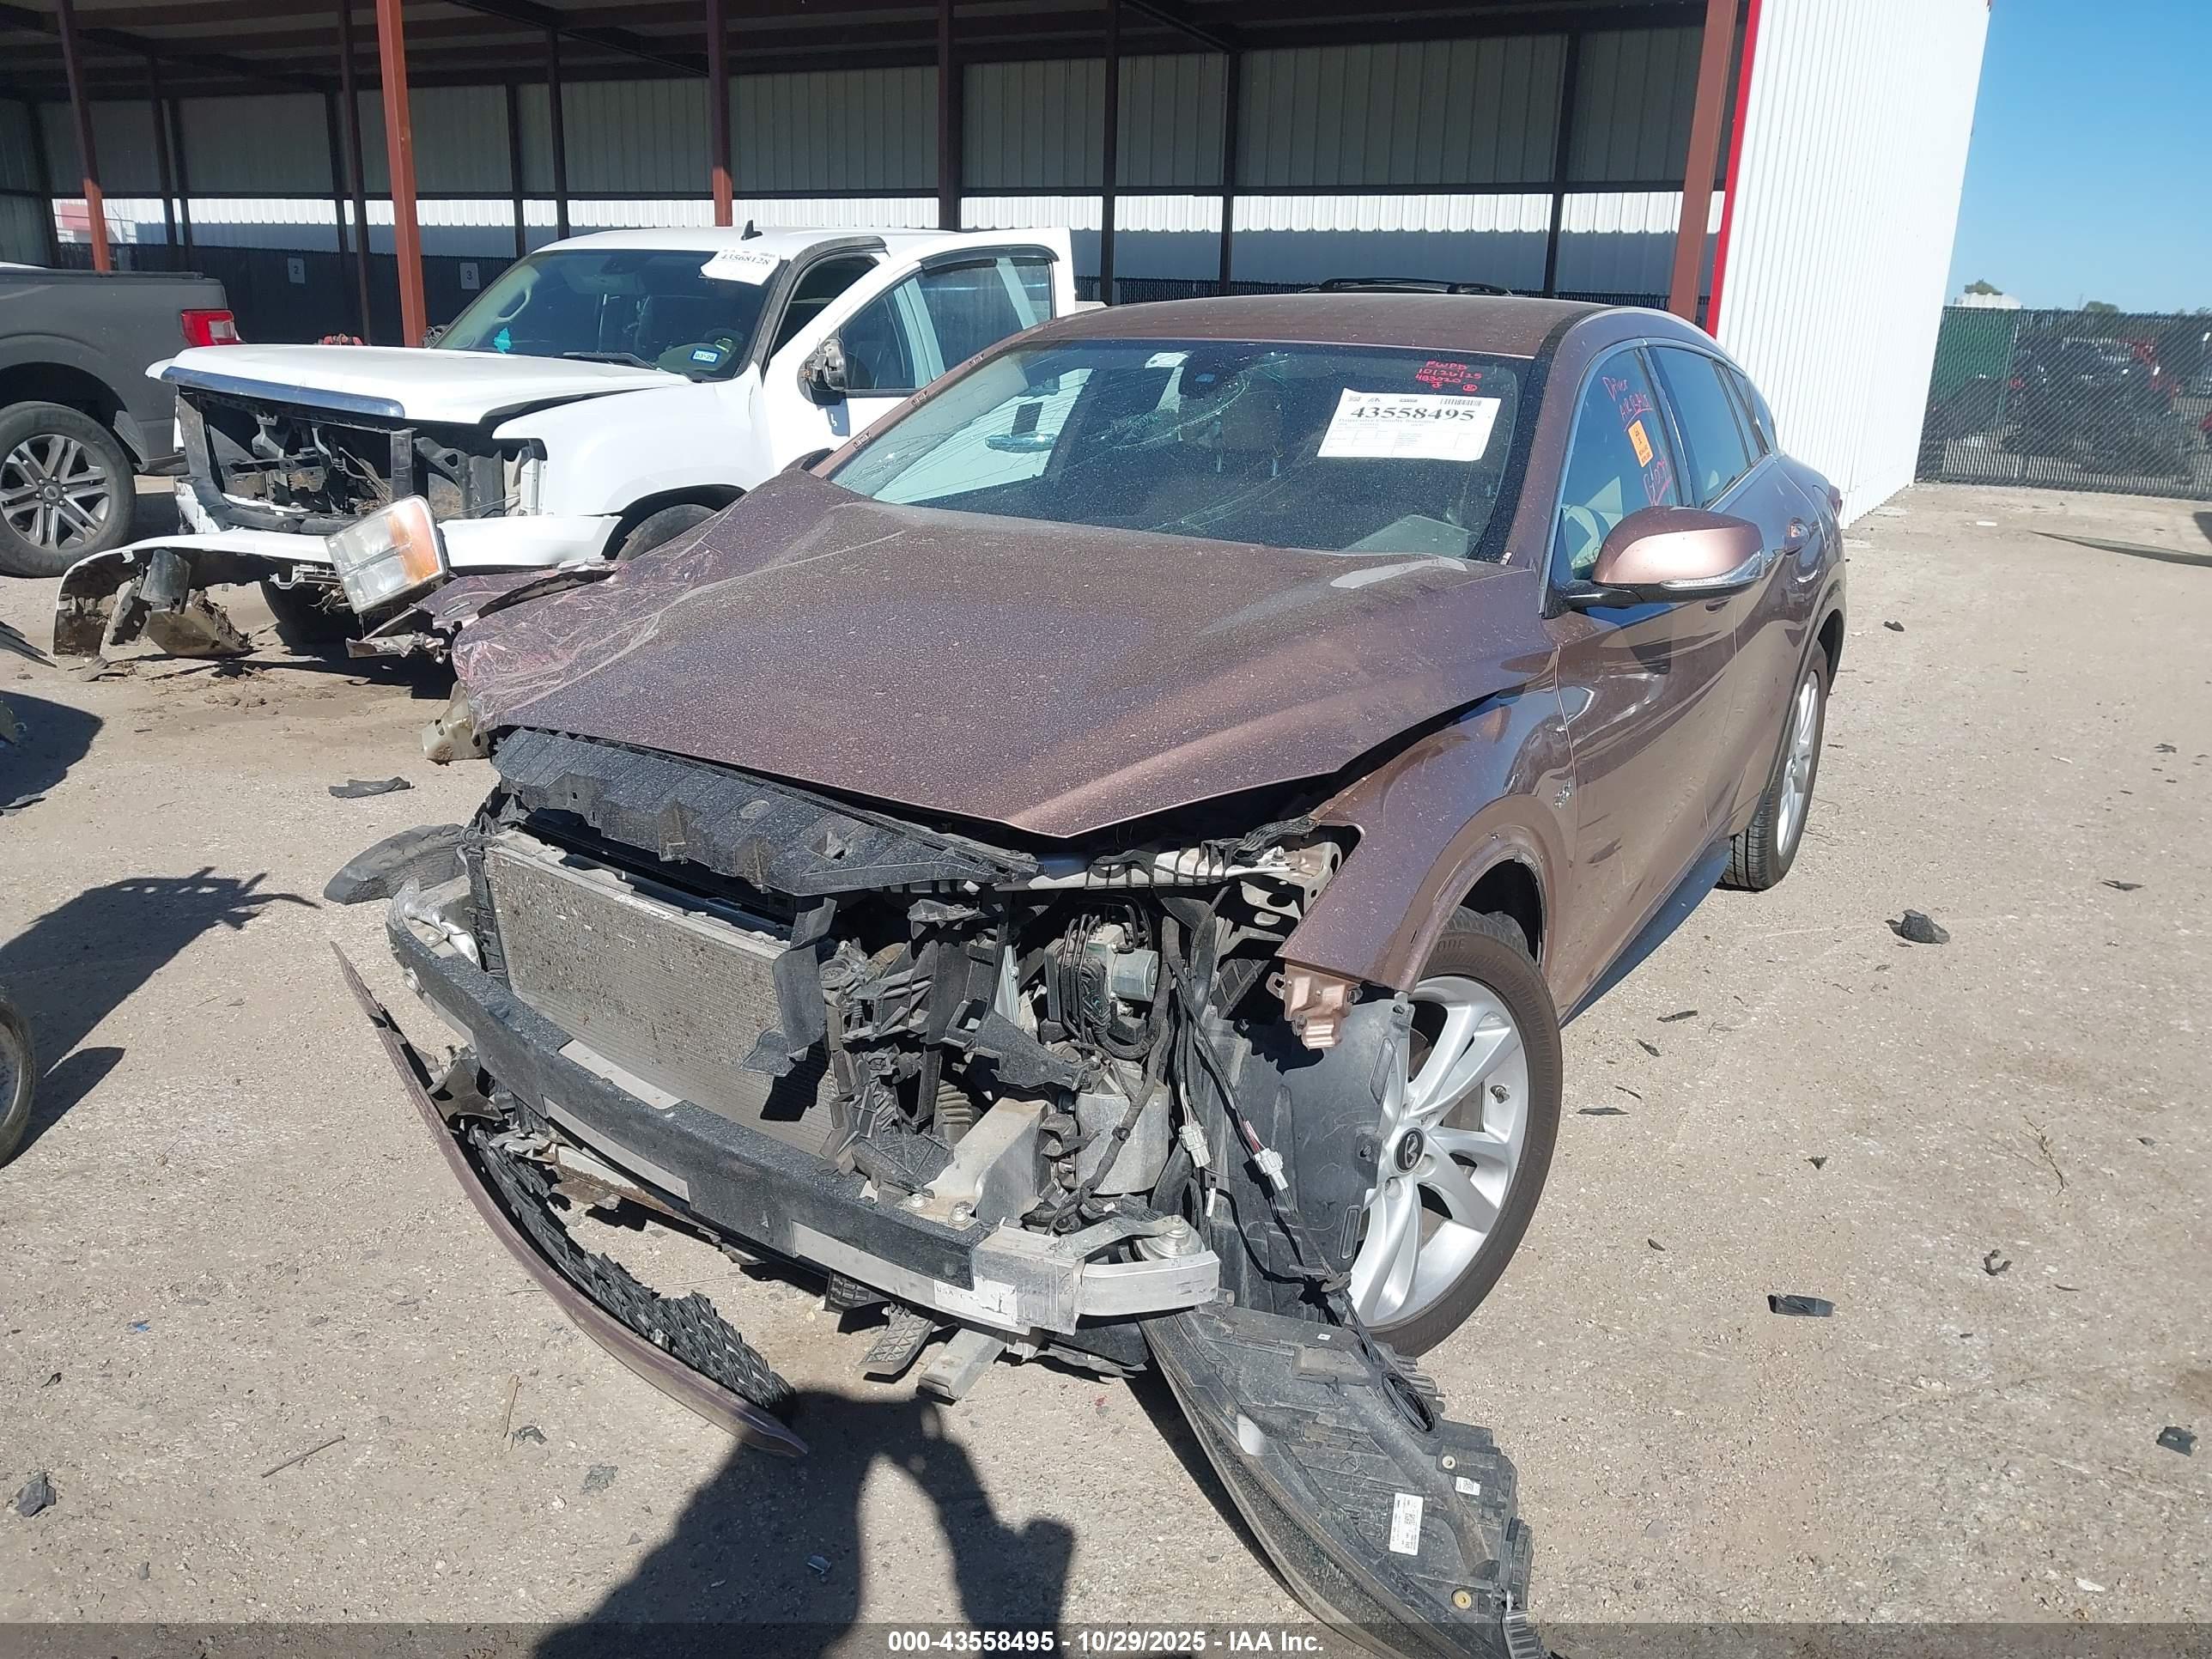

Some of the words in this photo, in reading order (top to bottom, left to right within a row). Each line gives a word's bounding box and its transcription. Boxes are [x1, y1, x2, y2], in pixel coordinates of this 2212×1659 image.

[294, 265, 300, 275] 2
[466, 270, 472, 281] 3
[1351, 406, 1475, 421] 43558495
